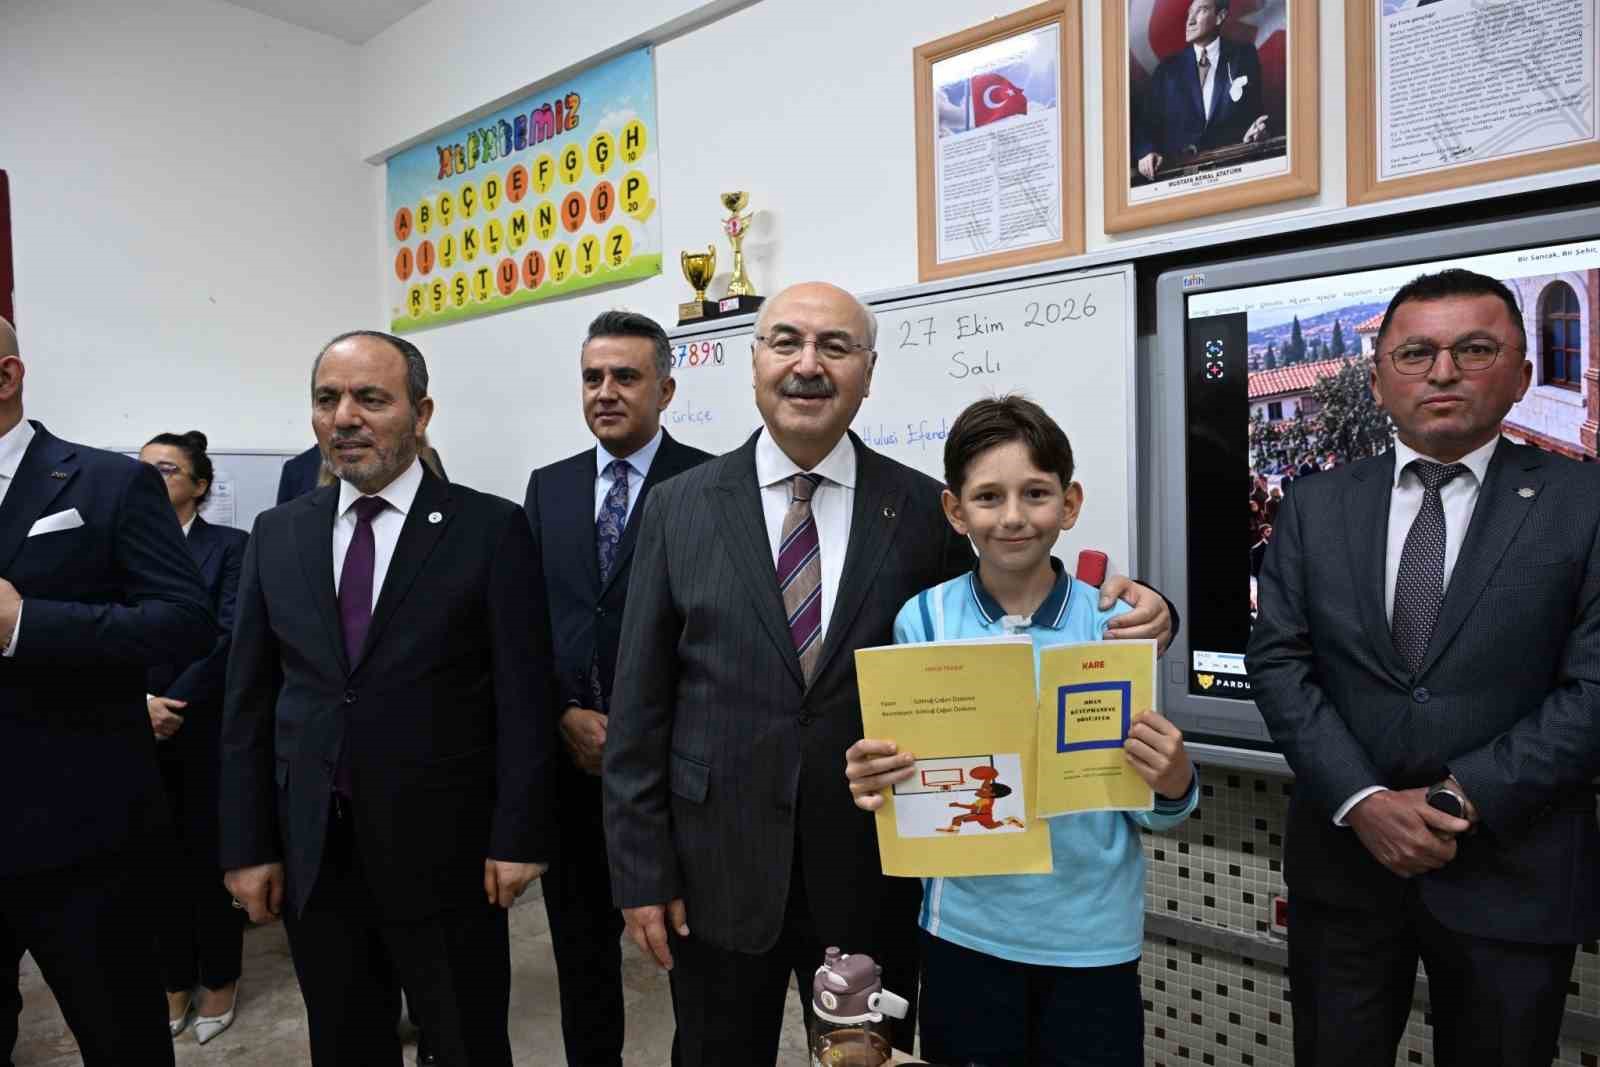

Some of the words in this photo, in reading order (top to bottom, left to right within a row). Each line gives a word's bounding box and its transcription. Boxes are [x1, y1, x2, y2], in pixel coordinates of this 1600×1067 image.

[400, 213, 408, 230] A
[420, 205, 429, 223] B
[441, 197, 450, 215] C
[487, 180, 497, 199] D
[512, 170, 522, 190] E
[539, 160, 548, 181] F
[565, 150, 577, 170] G
[596, 136, 608, 162] Ğ
[626, 126, 639, 149] H
[628, 151, 636, 160] 10
[444, 238, 451, 257] J
[465, 228, 476, 250] K
[489, 225, 498, 242] L
[513, 215, 525, 235] M
[540, 206, 552, 228] N
[569, 198, 580, 218] O
[598, 185, 608, 210] Ö
[627, 178, 640, 199] P
[412, 290, 420, 306] R
[433, 284, 442, 300] S
[456, 278, 464, 297] Ş
[478, 268, 488, 289] T
[503, 264, 512, 282] U
[528, 250, 539, 275] Ü
[555, 249, 565, 268] V
[583, 240, 593, 261] Y
[612, 234, 622, 256] Z
[900, 317, 936, 348] 27
[956, 313, 1004, 340] Ekim
[1024, 293, 1097, 327] 2026
[949, 351, 1001, 379] Salı
[1082, 661, 1104, 670] KARE
